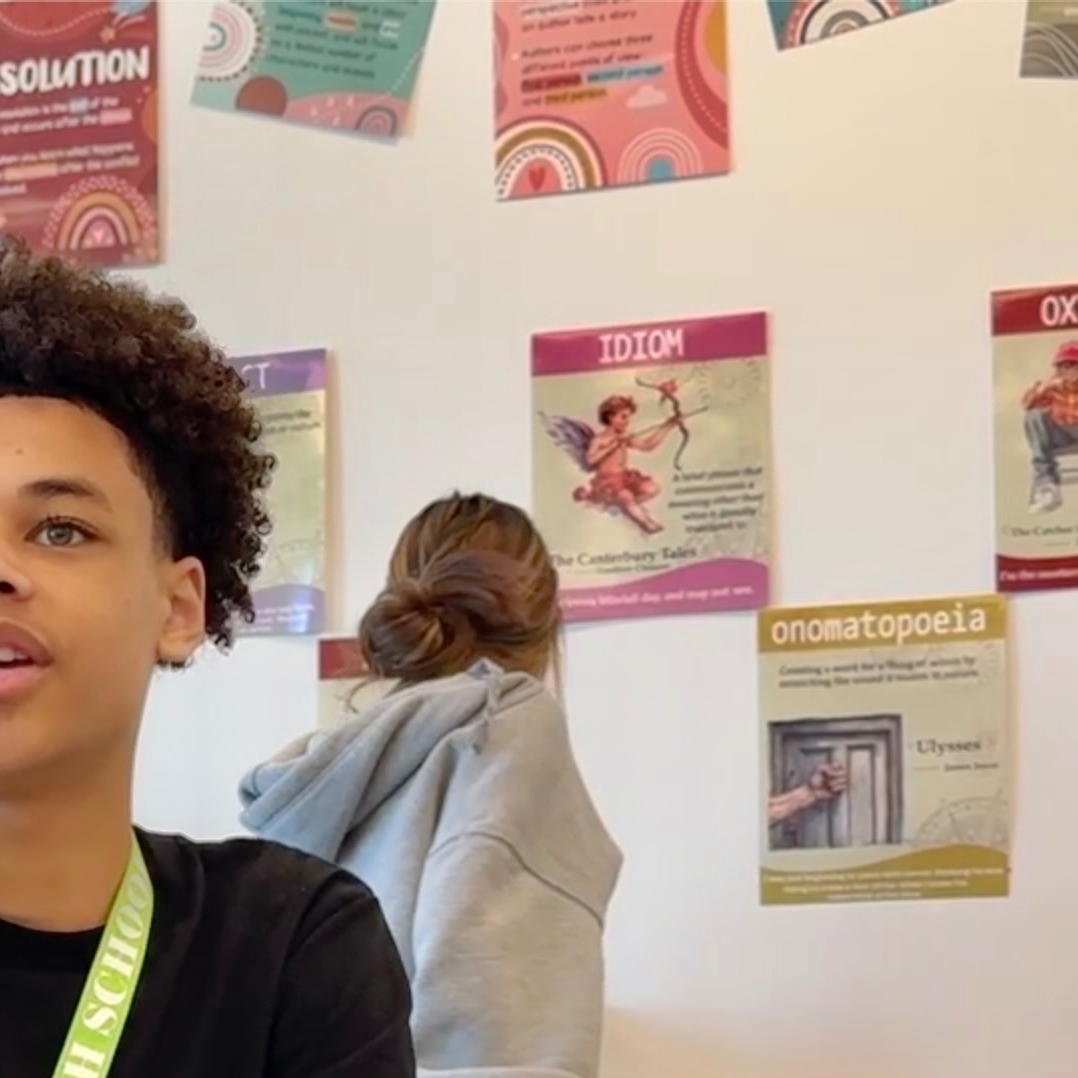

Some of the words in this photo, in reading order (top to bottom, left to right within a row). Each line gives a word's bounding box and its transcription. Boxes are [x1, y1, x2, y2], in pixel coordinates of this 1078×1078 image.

[599, 328, 684, 364] IDIOM
[772, 602, 987, 645] onomatopoeia
[917, 738, 982, 756] Ulysses
[83, 873, 150, 1036] SCHOO
